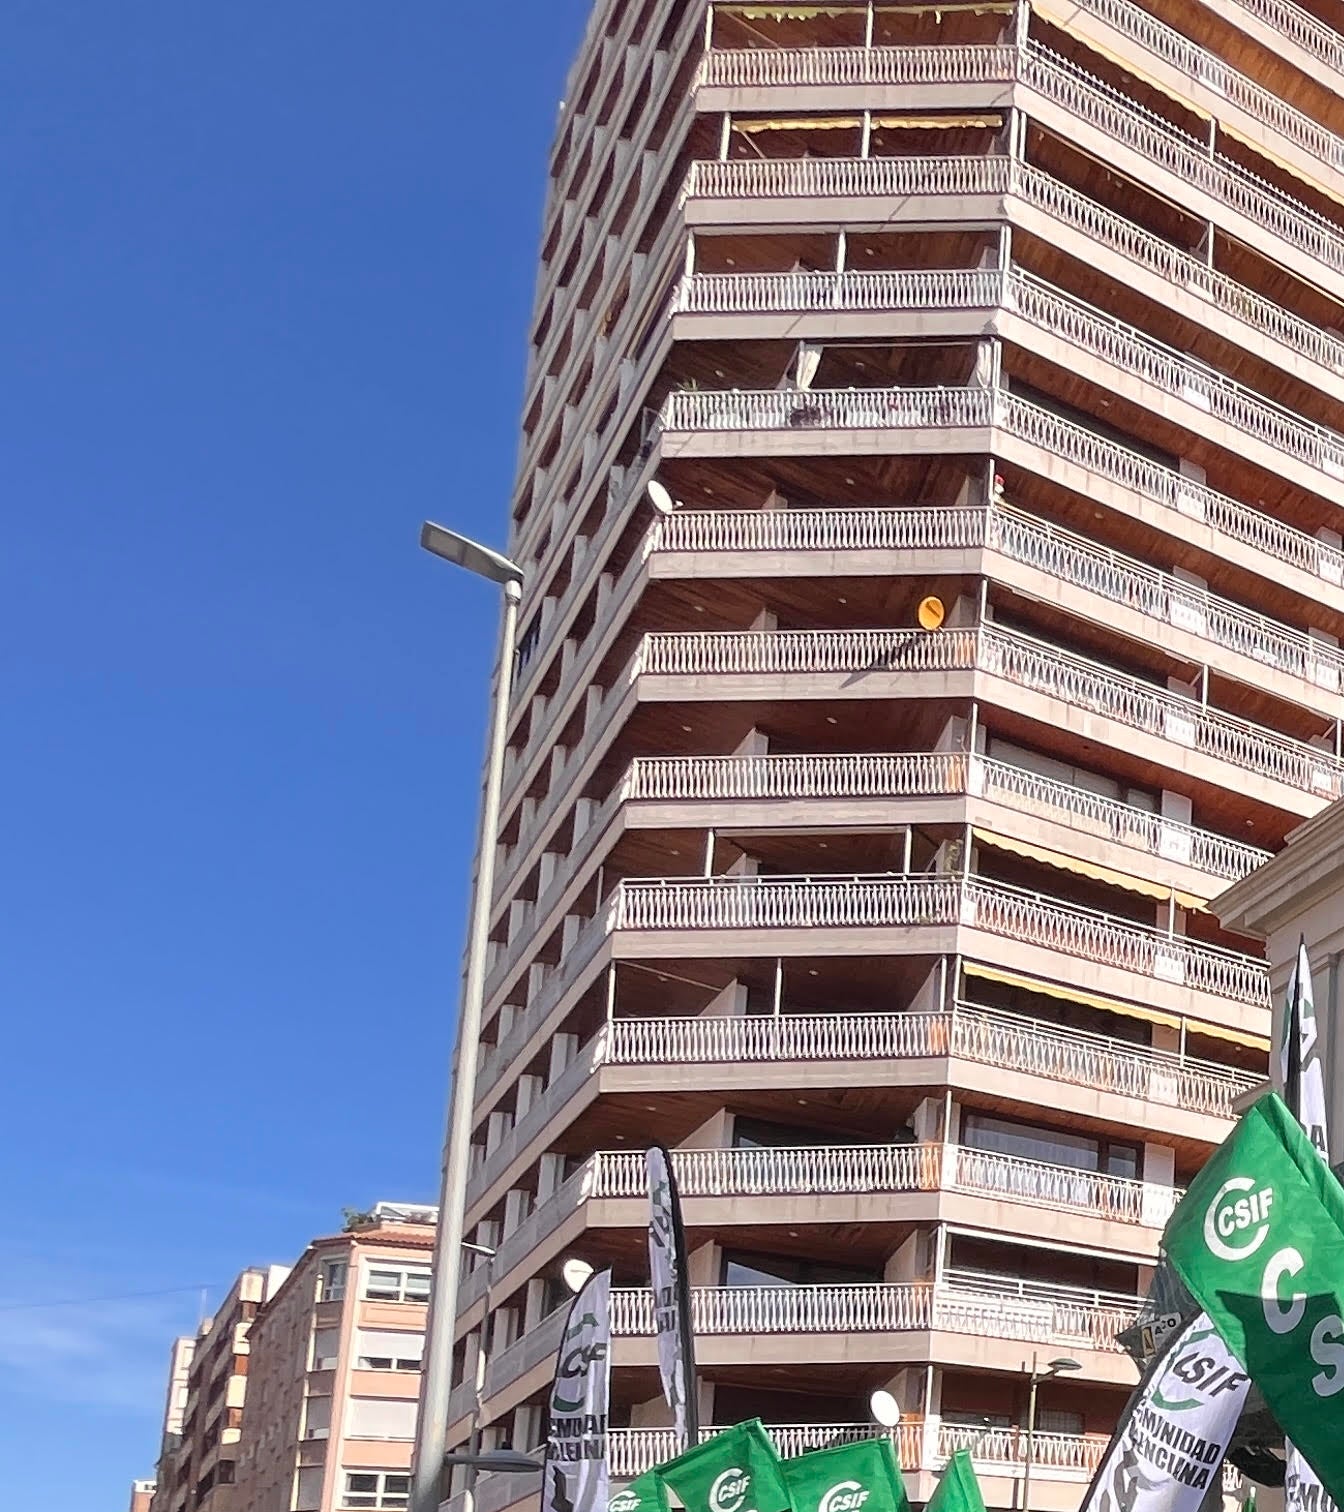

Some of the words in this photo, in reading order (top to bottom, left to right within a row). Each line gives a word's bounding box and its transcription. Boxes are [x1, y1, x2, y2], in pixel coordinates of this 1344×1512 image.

[1218, 1187, 1273, 1237] CSIF
[718, 1475, 750, 1502] CSIF
[829, 1490, 869, 1512] CSIF
